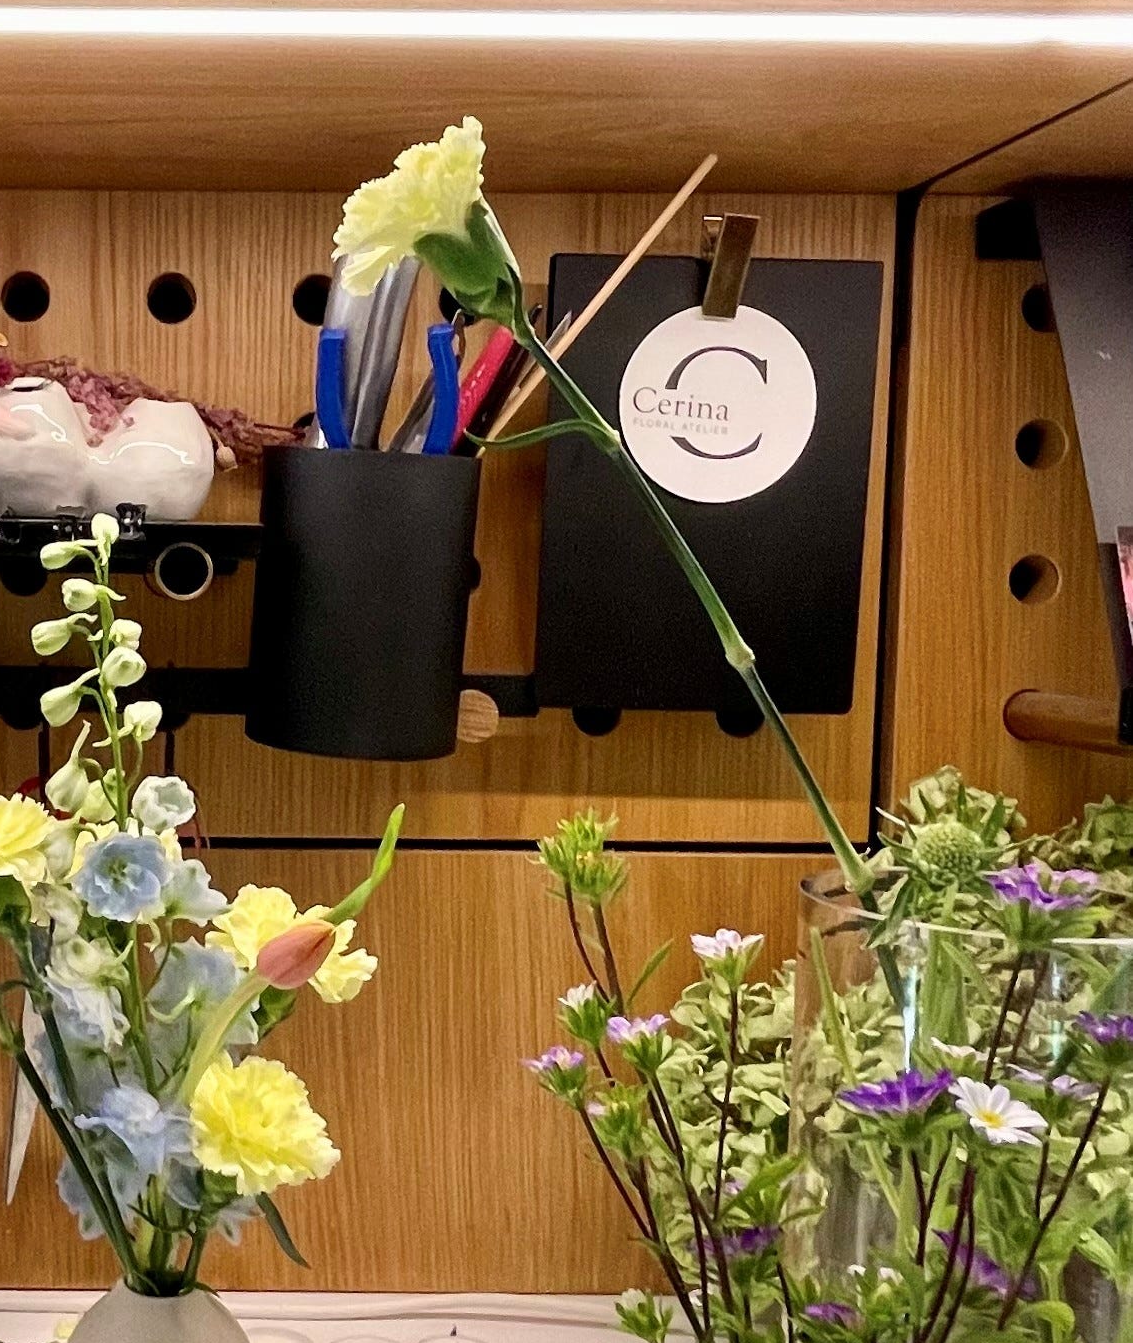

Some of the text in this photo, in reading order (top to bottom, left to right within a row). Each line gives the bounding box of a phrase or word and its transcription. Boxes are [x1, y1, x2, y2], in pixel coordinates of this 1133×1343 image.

[632, 386, 730, 423] Cerina
[633, 416, 729, 436] FLORAL ATELIER
